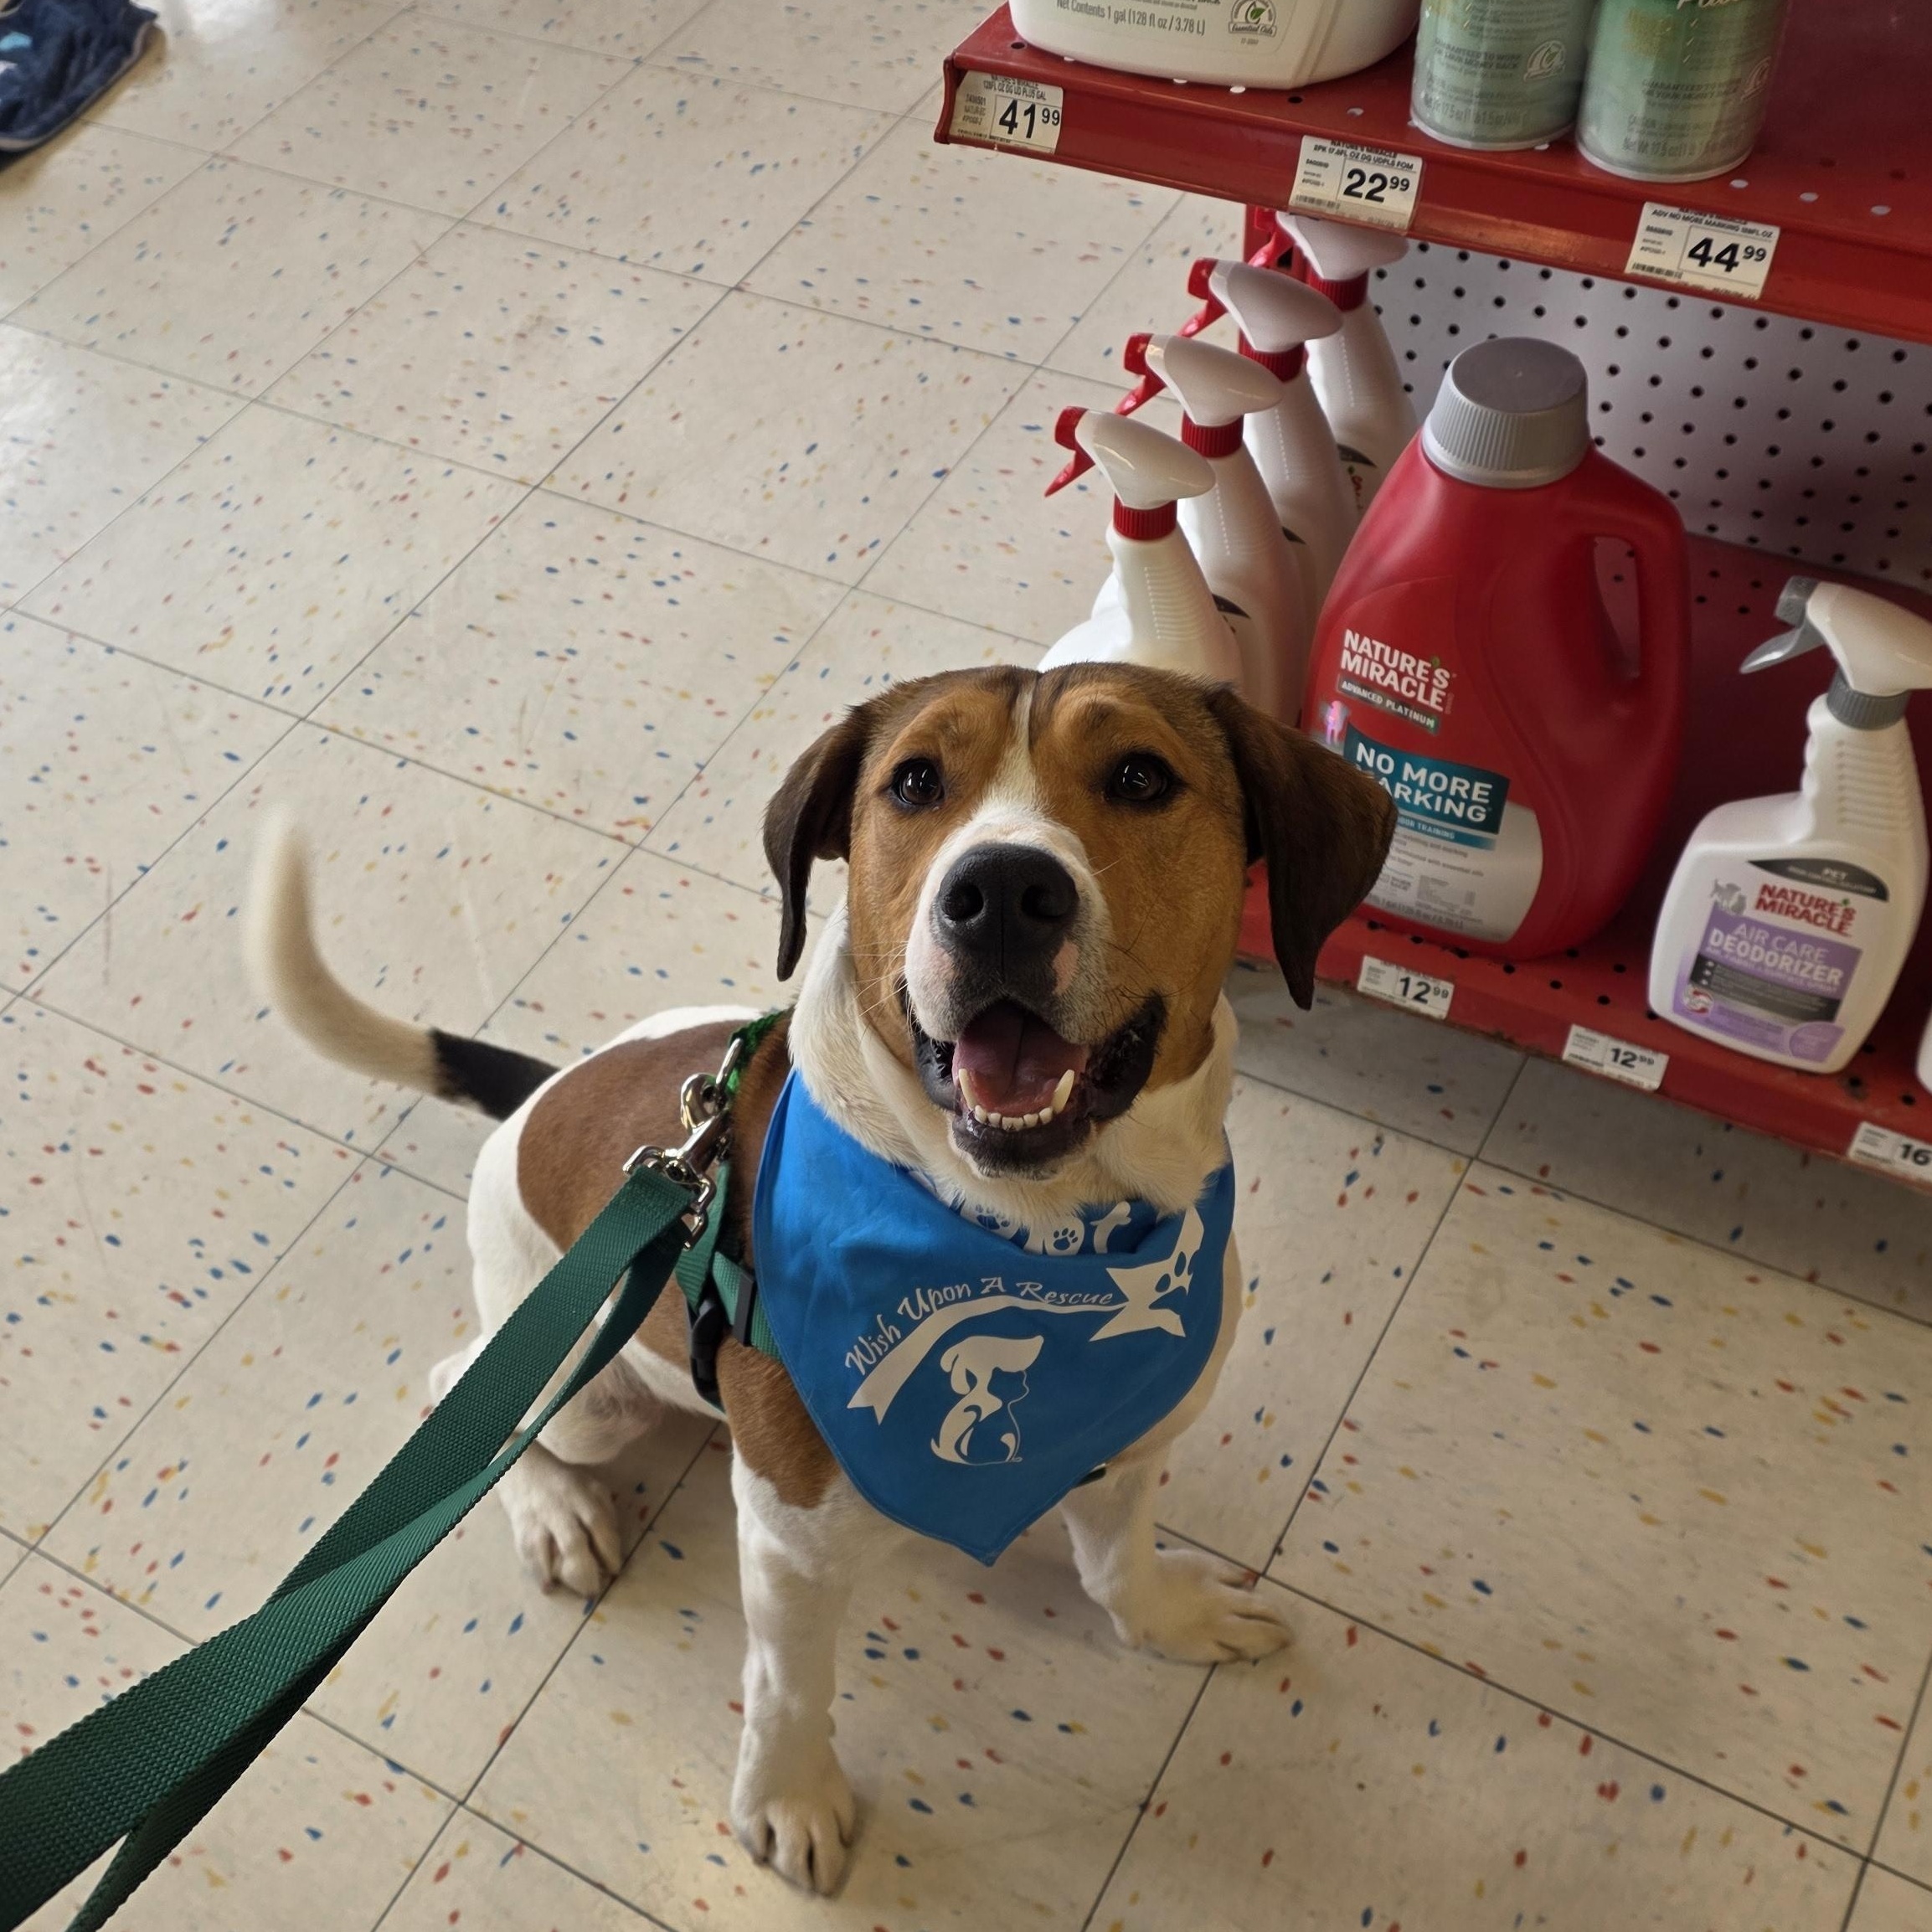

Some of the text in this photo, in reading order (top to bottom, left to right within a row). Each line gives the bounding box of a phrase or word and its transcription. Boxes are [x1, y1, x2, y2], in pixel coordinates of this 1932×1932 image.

[1071, 0, 1105, 18] Contents
[1113, 8, 1126, 23] gal
[1157, 16, 1168, 29] oz
[1175, 16, 1195, 33] 3.78
[1341, 648, 1446, 712] MIRACLE
[1344, 629, 1450, 689] NATURE'S
[1341, 680, 1383, 704] ADVANCED
[1386, 699, 1435, 729] PLATINUM
[1356, 742, 1493, 804] NO MORE
[1373, 772, 1487, 823] ARKING
[1754, 897, 1852, 938] MIRACLE
[1760, 884, 1857, 922] NATURE'S
[1709, 928, 1844, 986] DEODORIZER
[1733, 923, 1829, 963] AIR CARE
[845, 1276, 1114, 1376] Wish Upon A Rescue
